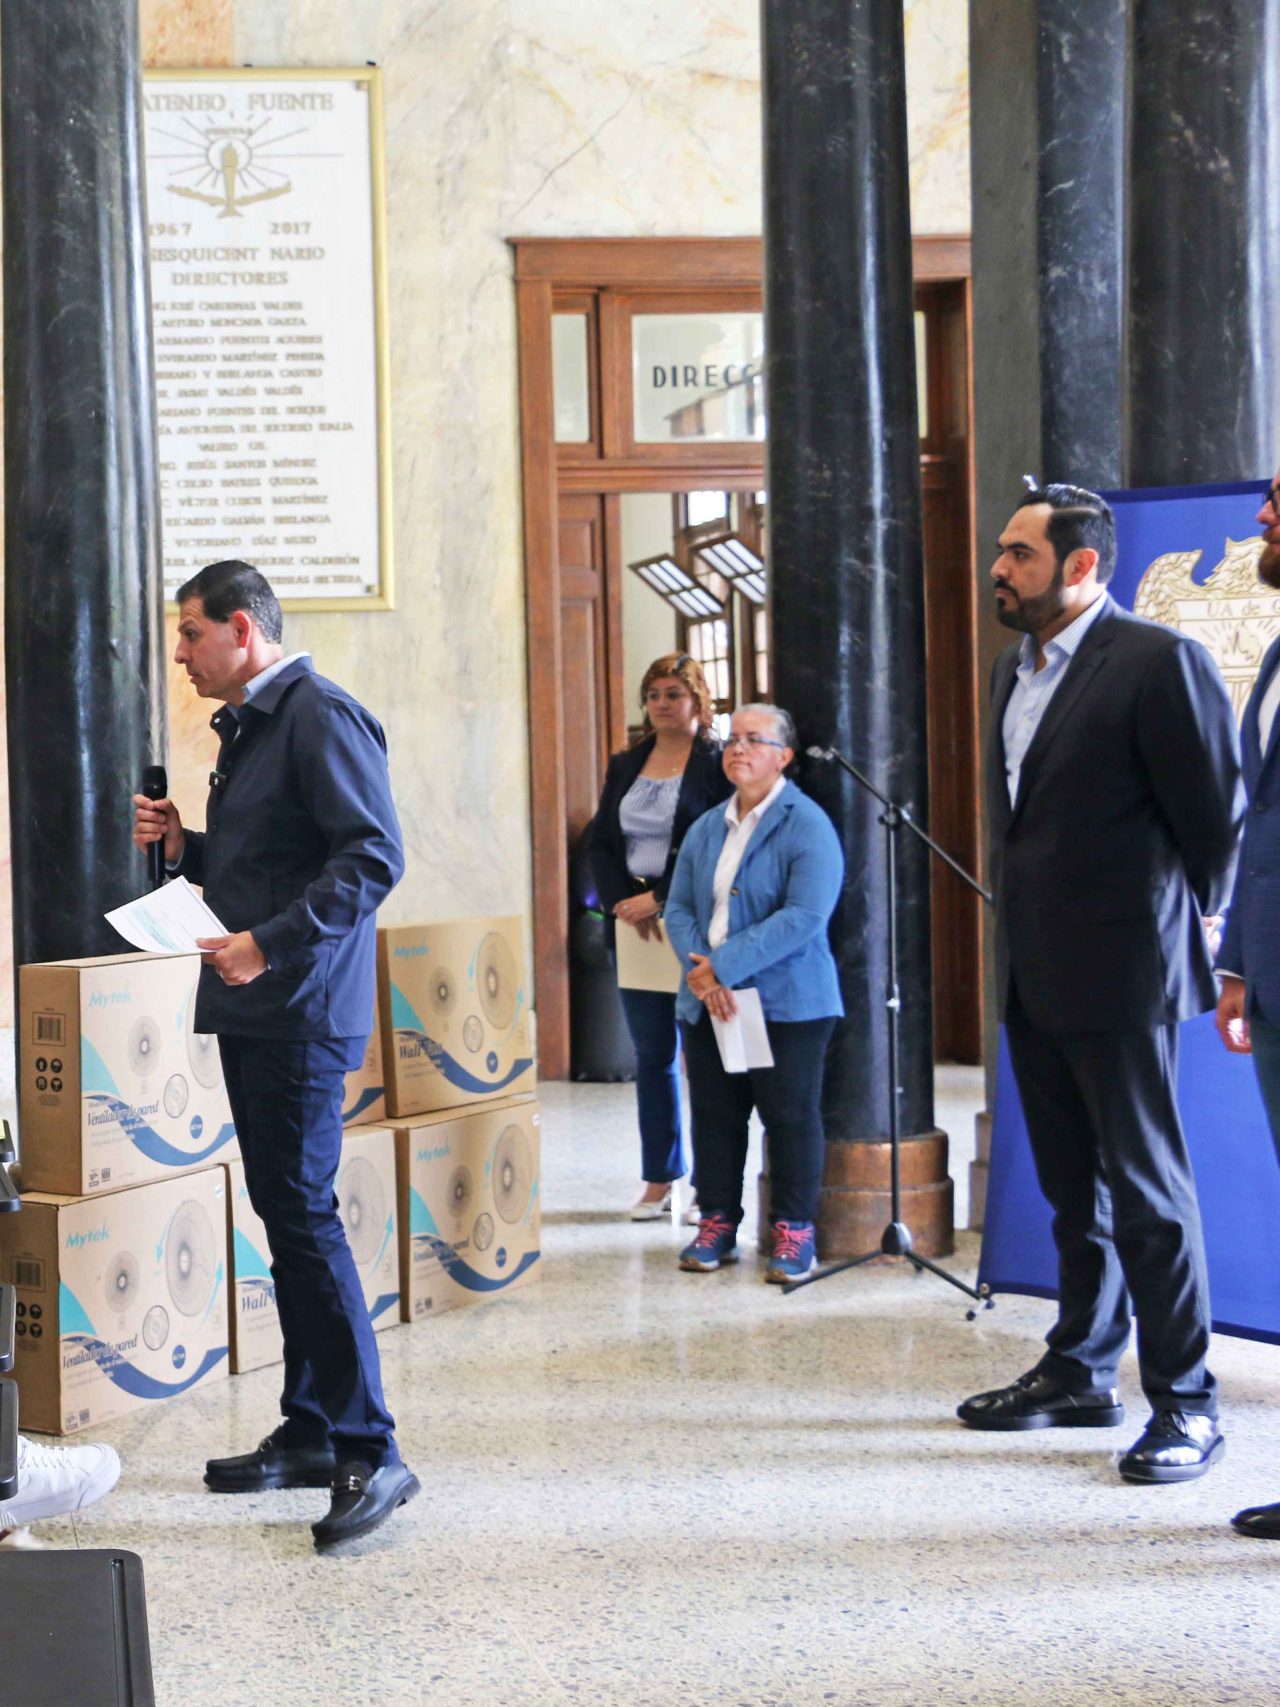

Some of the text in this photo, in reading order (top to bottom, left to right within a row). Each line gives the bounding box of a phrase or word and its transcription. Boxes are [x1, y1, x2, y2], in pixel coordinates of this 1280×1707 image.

[248, 93, 334, 111] FUENTE
[269, 221, 312, 235] 2017
[171, 271, 289, 286] DIRECTORES
[652, 363, 754, 389] DIRECC
[392, 940, 430, 960] Mytek
[415, 1143, 452, 1163] Mytek
[65, 1224, 110, 1248] Mytek
[241, 1292, 268, 1312] Wall
